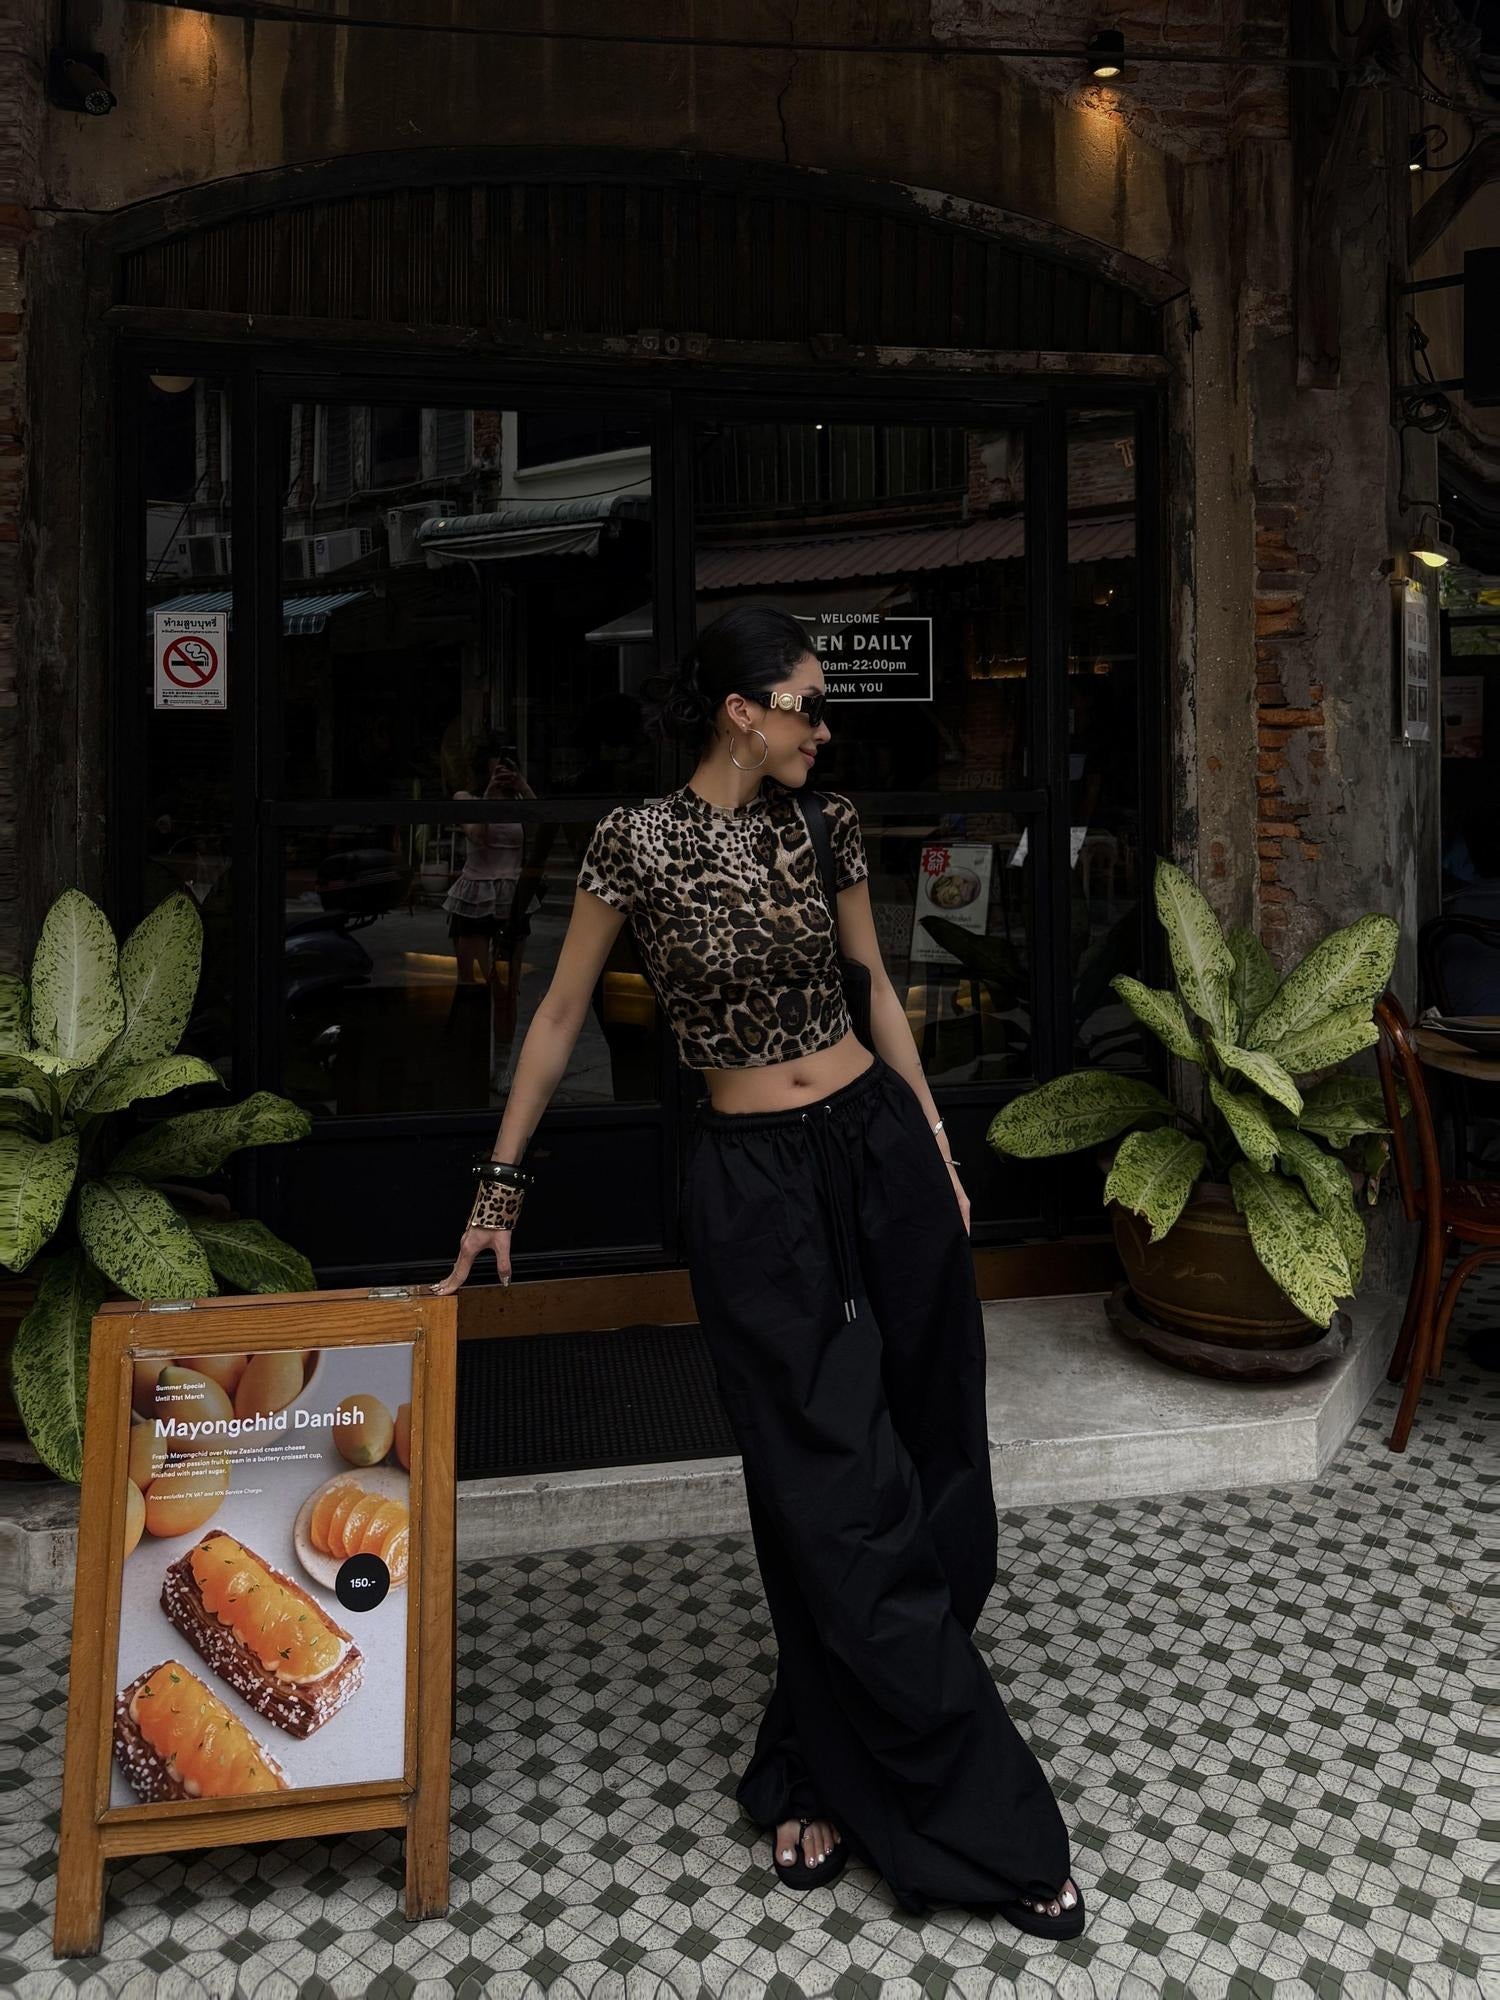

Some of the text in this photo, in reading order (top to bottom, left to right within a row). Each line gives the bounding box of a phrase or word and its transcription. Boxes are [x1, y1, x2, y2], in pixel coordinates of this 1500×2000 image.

[163, 617, 217, 629] ห้ามสูบบุหรี่
[821, 613, 880, 624] WELCOME
[810, 634, 913, 652] EN DAILY
[822, 659, 907, 672] 0am-22:00pm
[825, 682, 884, 693] HANK YOU
[155, 1382, 206, 1392] Summer Special
[184, 1393, 205, 1401] March
[155, 1405, 365, 1440] Mayongchid Danish
[151, 1453, 169, 1461] Fresh
[169, 1450, 209, 1461] Mayongchid
[239, 1446, 263, 1455] Zealand
[164, 1462, 186, 1471] mango
[186, 1460, 210, 1469] passion
[211, 1458, 225, 1466] fruit
[257, 1455, 280, 1464] buttery
[281, 1453, 308, 1461] croissant
[151, 1468, 227, 1478] finished with pearl sugar.
[349, 1577, 376, 1588] 150.-
